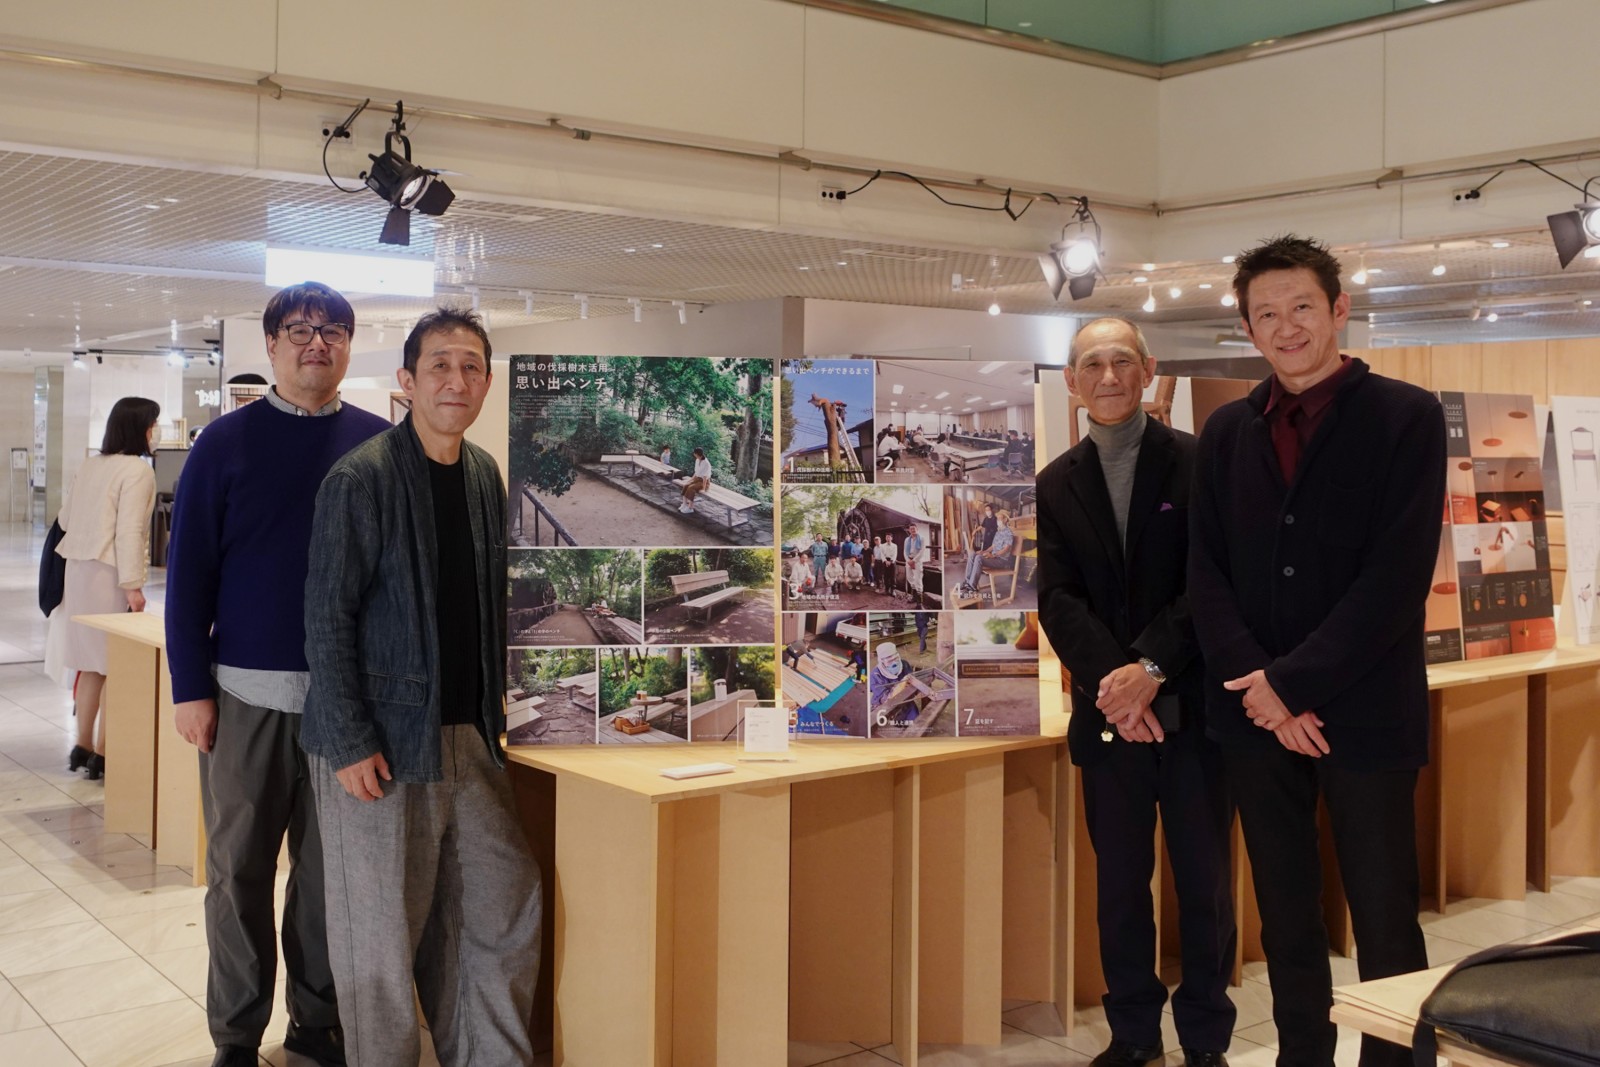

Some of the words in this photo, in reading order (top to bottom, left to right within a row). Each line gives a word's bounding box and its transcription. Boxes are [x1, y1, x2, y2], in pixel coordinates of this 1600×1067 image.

[516, 362, 608, 373] 地域の伐採樹木活用
[515, 375, 607, 391] 思い出ベンチ
[883, 456, 894, 473] 2
[876, 709, 888, 726] 6
[963, 708, 974, 725] 7
